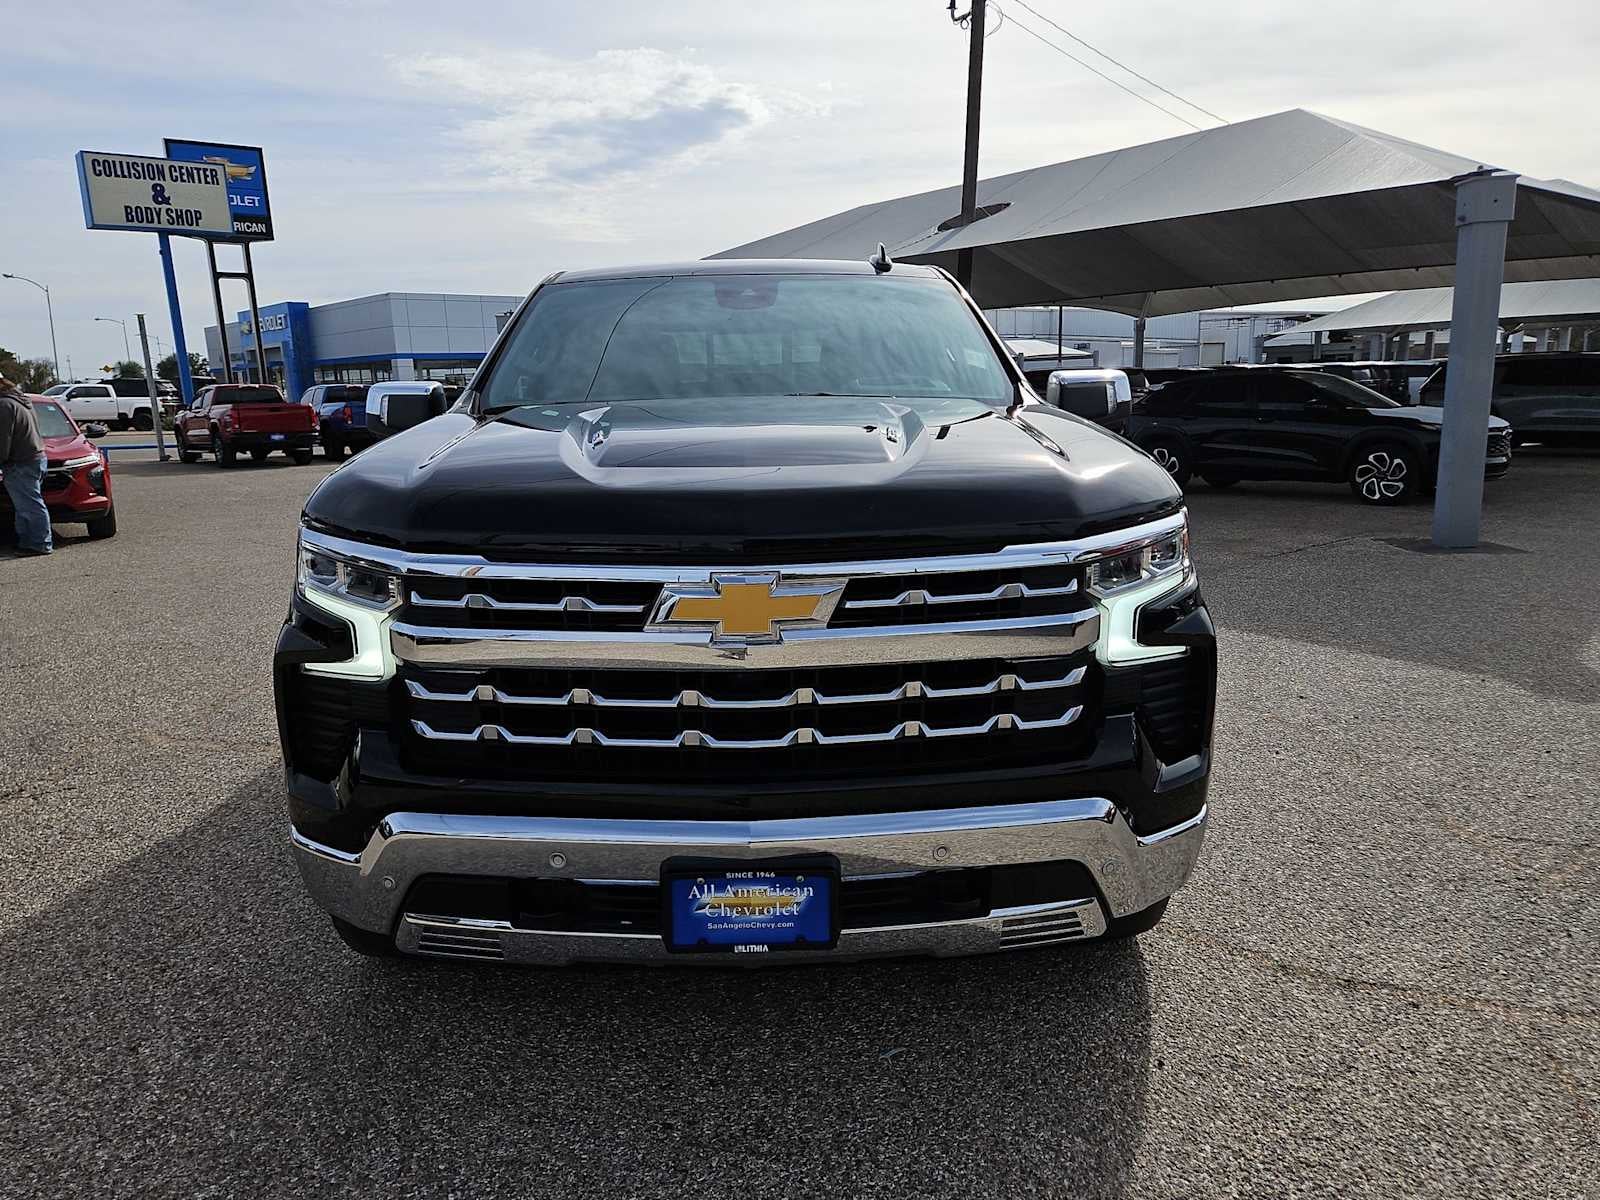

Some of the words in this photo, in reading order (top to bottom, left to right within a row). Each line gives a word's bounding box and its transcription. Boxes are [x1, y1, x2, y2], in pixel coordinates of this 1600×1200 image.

[91, 158, 166, 182] COLLISION
[169, 165, 220, 186] CENTER
[151, 183, 172, 205] &
[229, 194, 260, 206] OLET
[124, 205, 162, 225] BODY
[165, 208, 202, 227] SHOP
[233, 221, 266, 233] RICAN
[688, 884, 715, 899] All
[723, 883, 814, 899] American
[705, 902, 799, 918] Chevrolet
[707, 921, 794, 930] SanAngeloChevy.com
